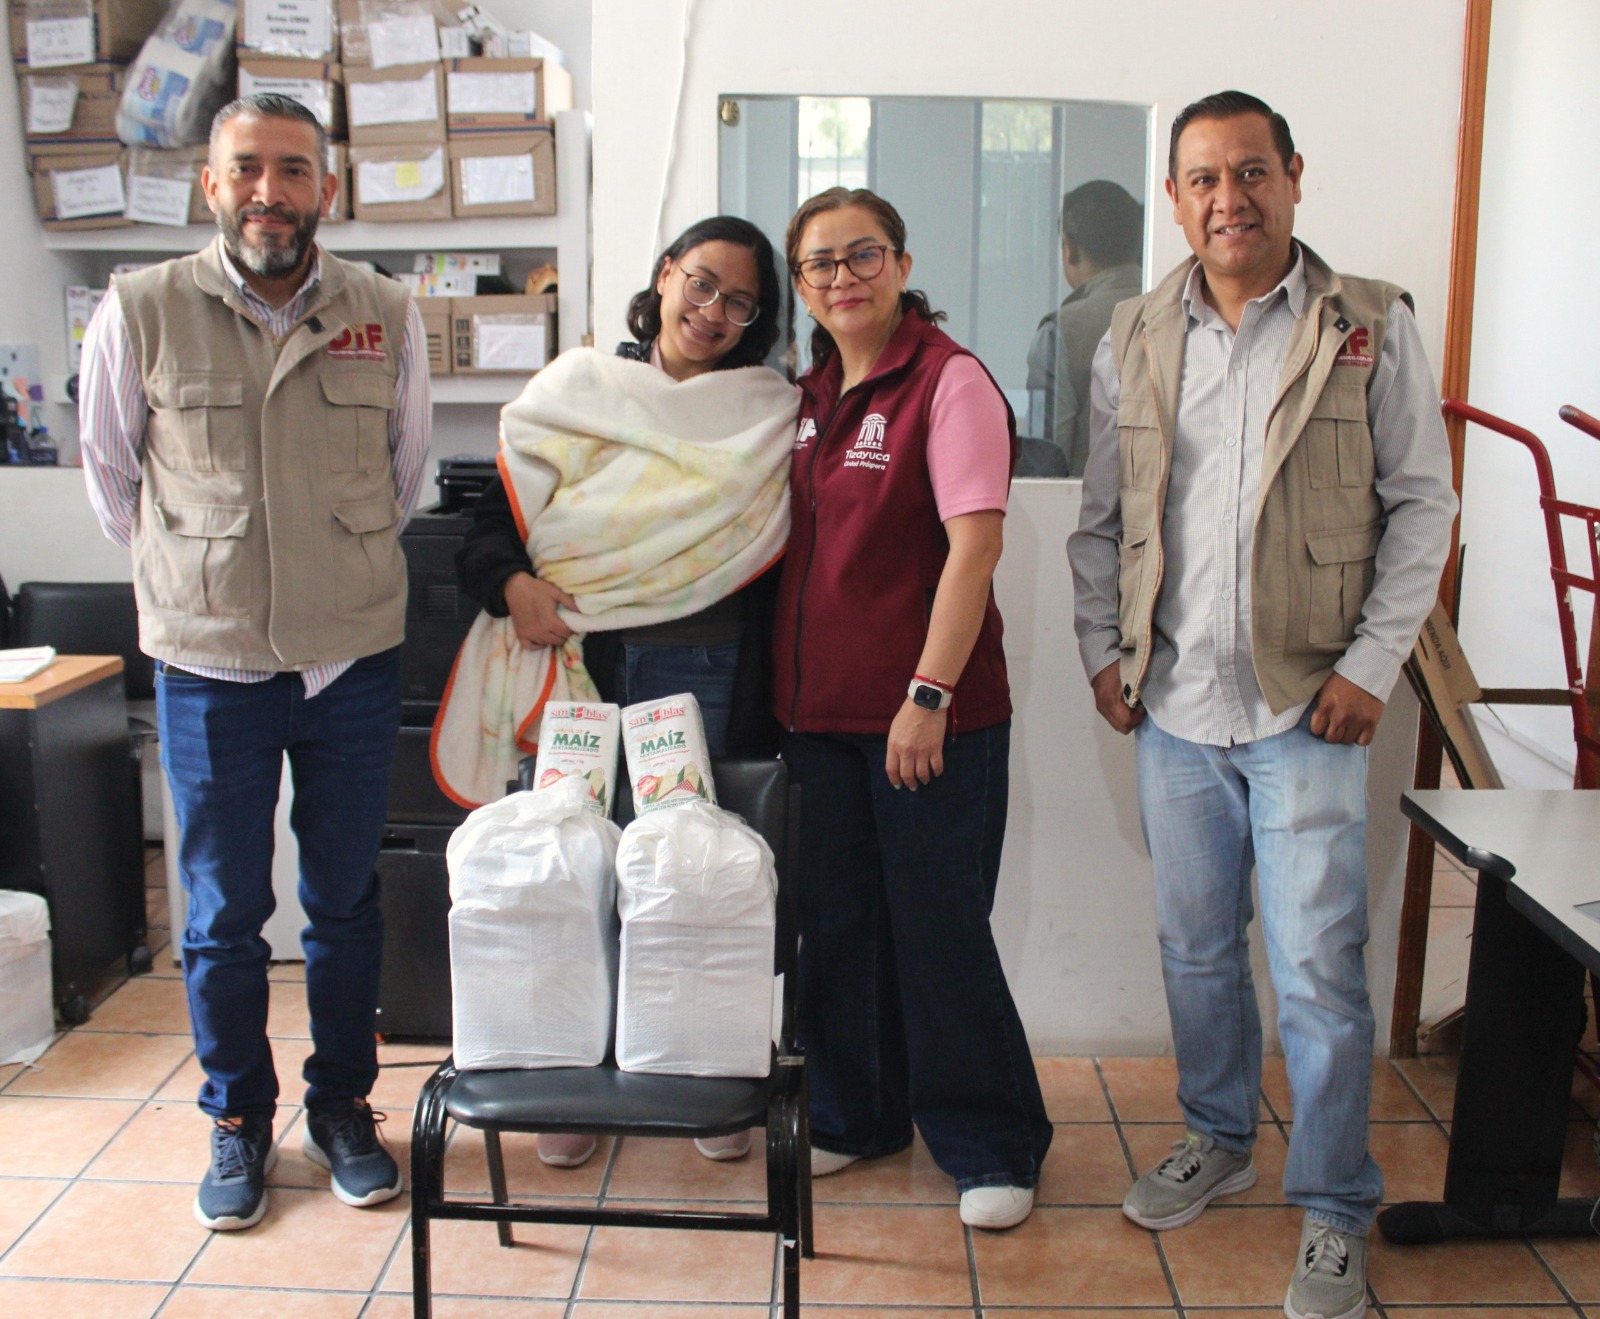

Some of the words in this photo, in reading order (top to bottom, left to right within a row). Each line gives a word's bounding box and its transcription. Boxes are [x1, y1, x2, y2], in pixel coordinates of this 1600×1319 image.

[845, 449, 890, 463] Tizayuca
[553, 731, 602, 749] MAÍZ
[640, 730, 686, 755] MAÍZ
